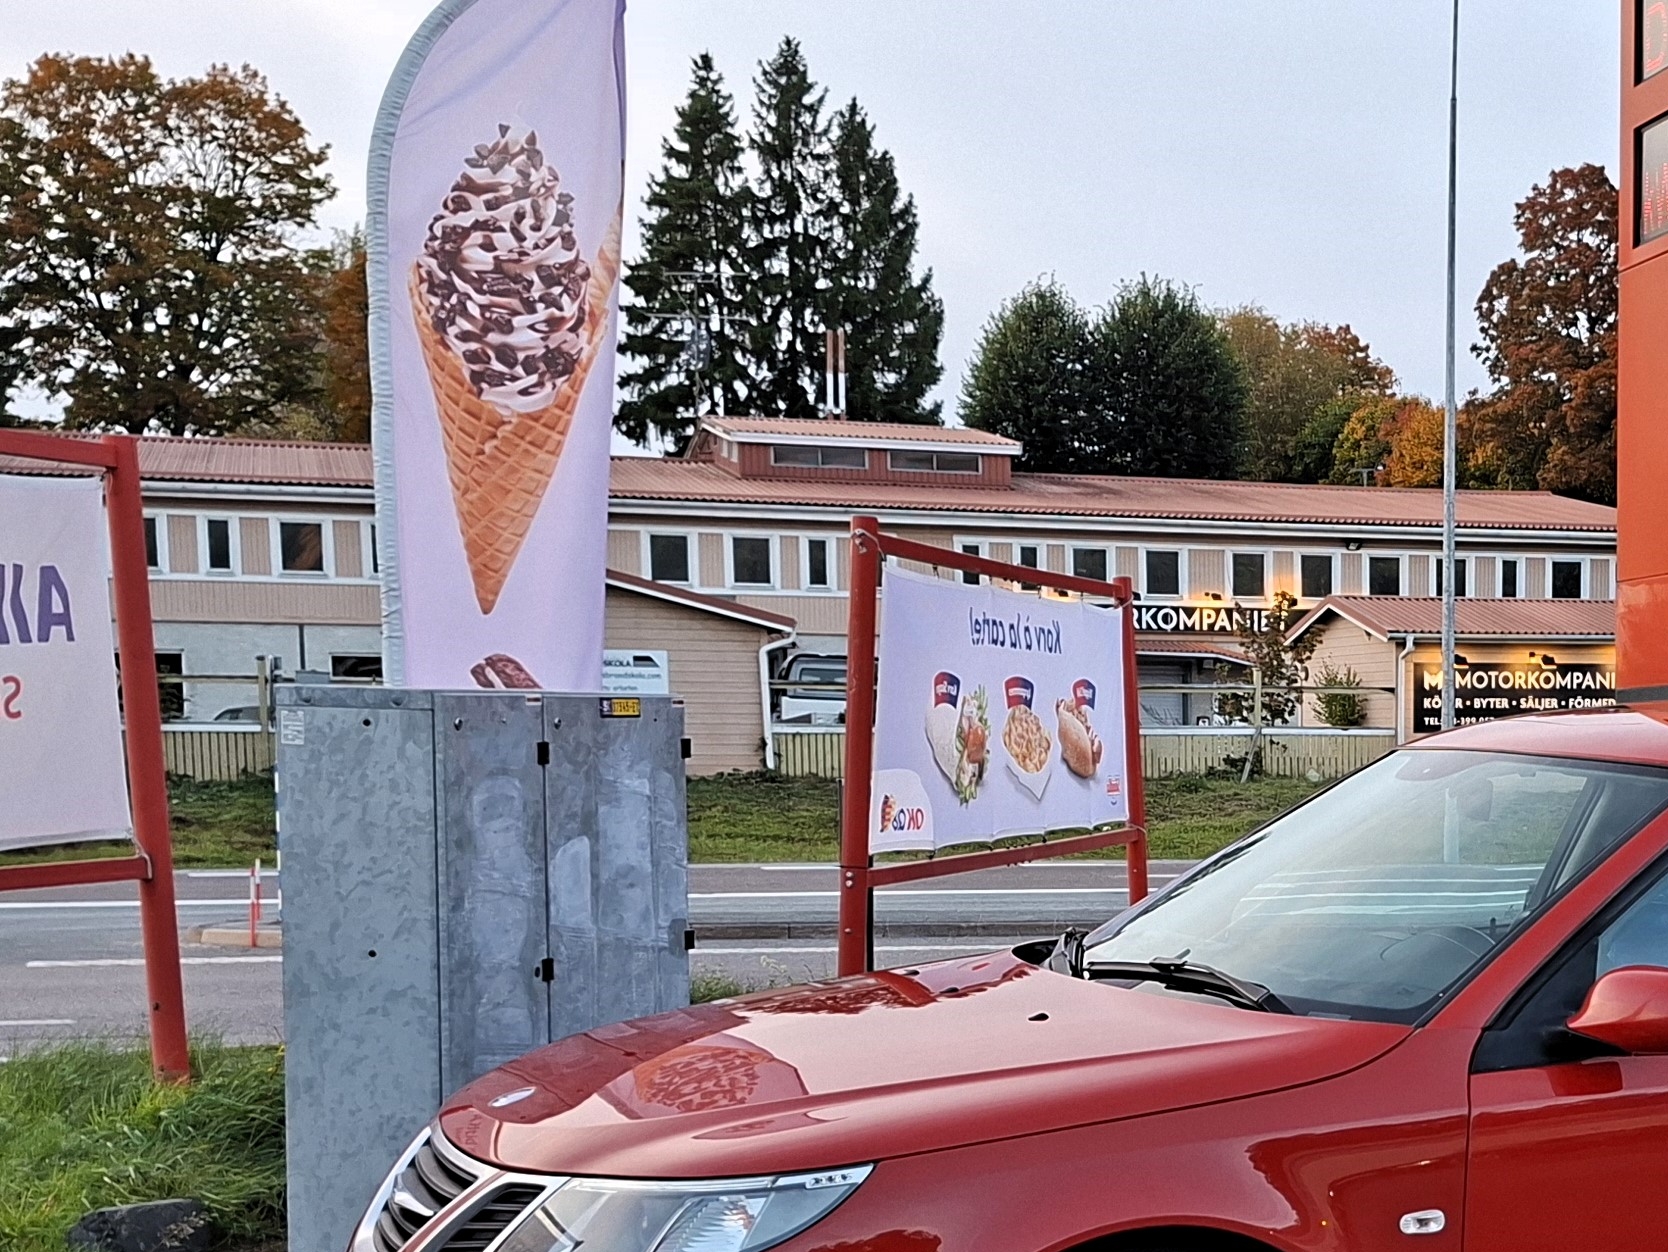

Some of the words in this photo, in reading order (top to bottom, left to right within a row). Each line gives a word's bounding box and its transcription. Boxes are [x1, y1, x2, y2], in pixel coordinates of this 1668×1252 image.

[1423, 694, 1463, 709] KÖR
[1473, 697, 1510, 709] BYTER
[1519, 695, 1559, 711] SÄLJER
